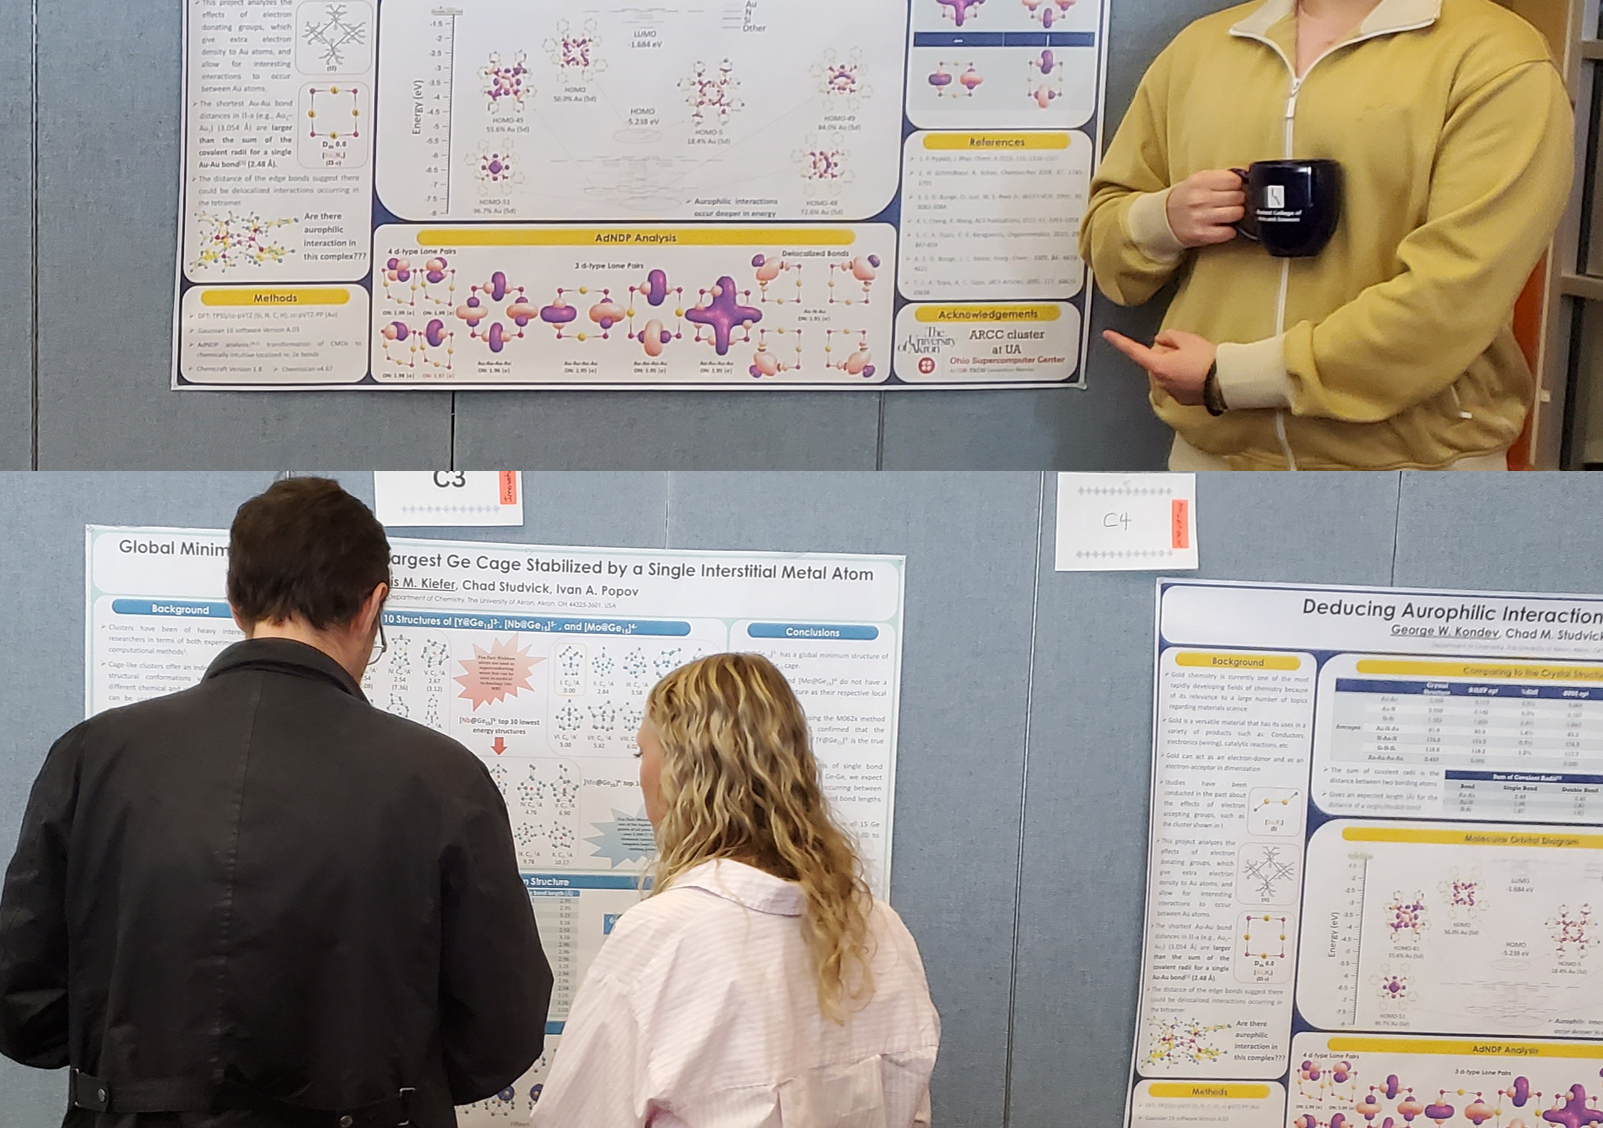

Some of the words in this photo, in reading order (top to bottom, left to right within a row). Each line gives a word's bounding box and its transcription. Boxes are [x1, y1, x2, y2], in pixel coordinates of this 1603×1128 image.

[303, 212, 319, 220] Are
[320, 212, 343, 220] there
[303, 226, 344, 234] aurophilic
[303, 239, 347, 247] interaction
[348, 239, 357, 247] in
[303, 253, 319, 261] this
[319, 252, 367, 261] complex???
[253, 293, 298, 303] Methods
[968, 329, 1005, 340] ARCC
[1006, 329, 1046, 340] cluster
[991, 346, 1003, 355] at
[1005, 344, 1022, 355] UA
[433, 470, 467, 488] C3
[1103, 512, 1132, 532] C4
[119, 539, 175, 555] Global
[180, 541, 228, 557] Minim
[391, 552, 442, 570] argest
[446, 554, 471, 569] Ge
[476, 555, 522, 574] Cage
[526, 558, 603, 574] Stabilized
[607, 560, 629, 578] by
[632, 564, 643, 576] a
[648, 562, 697, 580] Single
[701, 564, 777, 578] Interstitial
[781, 565, 827, 580] Metal
[831, 567, 874, 581] Atom
[1303, 598, 1396, 621] Deducing
[1401, 603, 1497, 622] Aurophilic
[1502, 606, 1603, 624] Interaction
